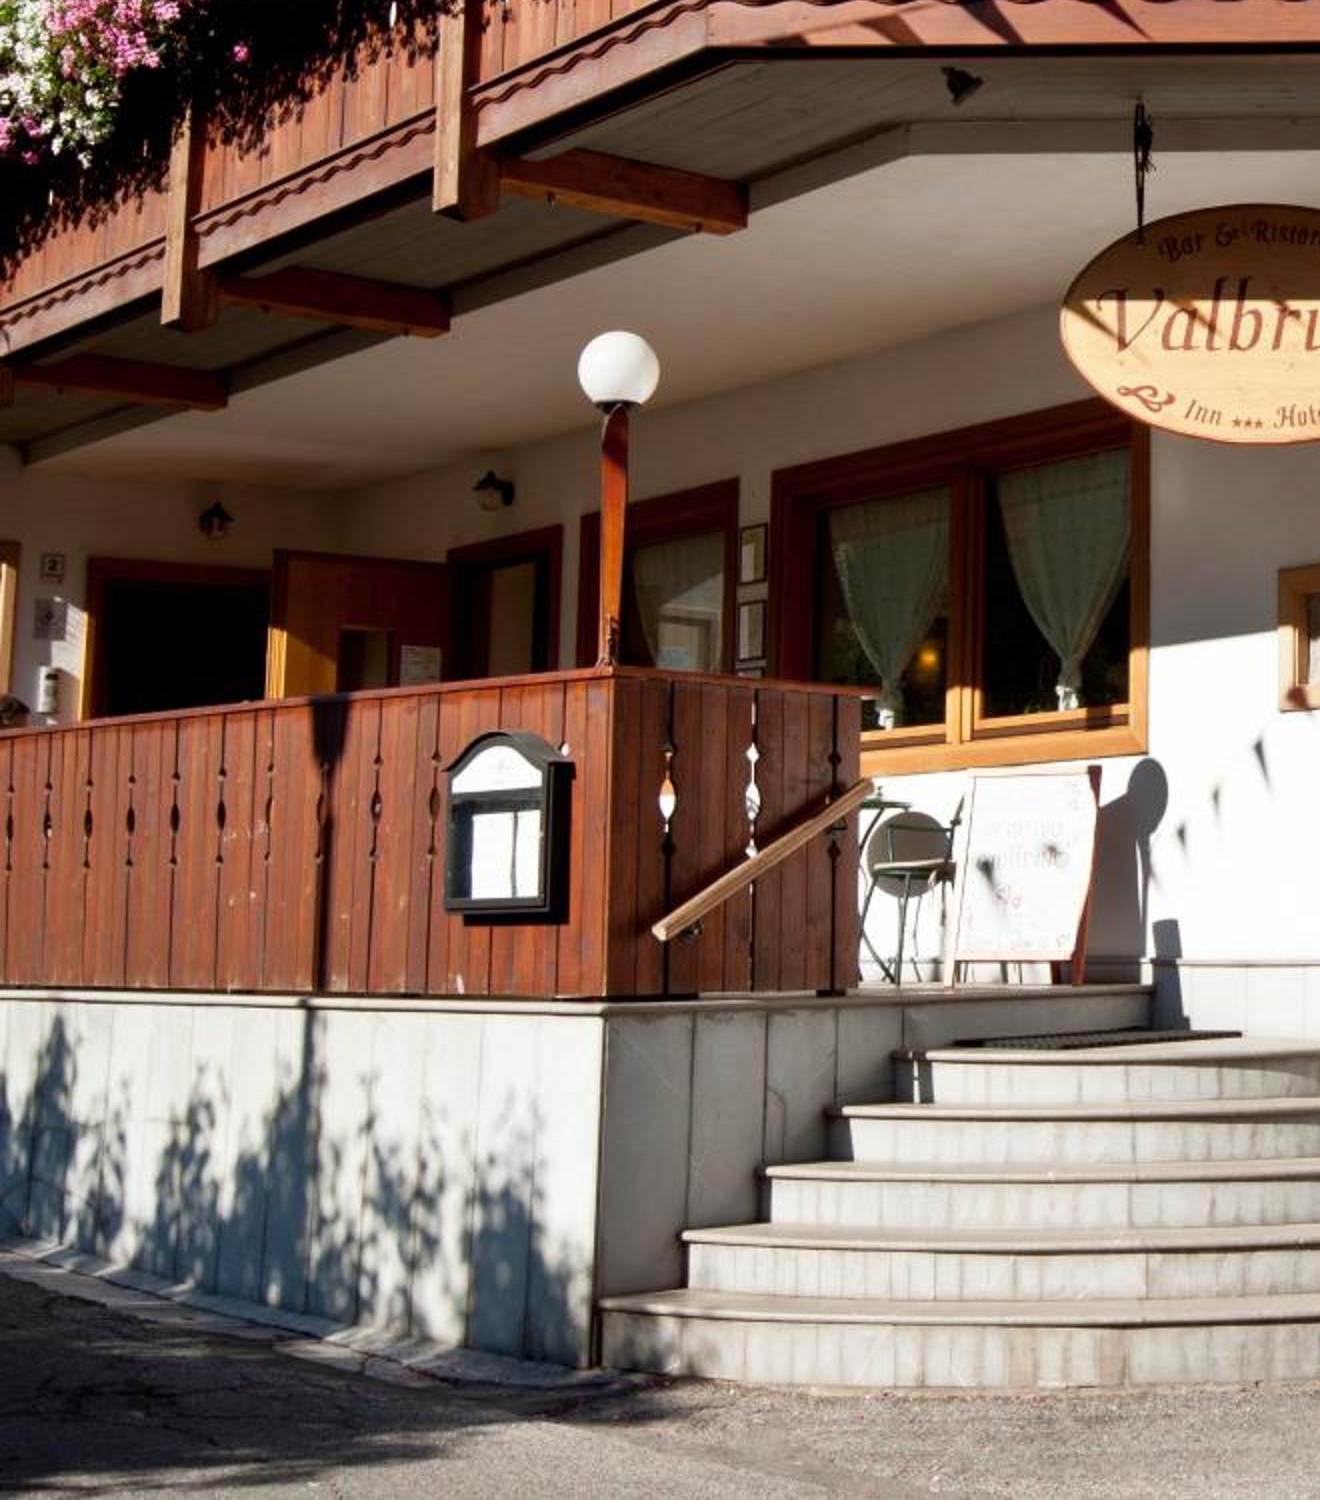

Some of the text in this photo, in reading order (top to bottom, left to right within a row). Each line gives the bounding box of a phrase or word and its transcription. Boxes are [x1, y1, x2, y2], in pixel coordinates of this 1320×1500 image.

[1157, 232, 1204, 262] Bar
[1215, 221, 1240, 247] &
[1184, 399, 1222, 426] Inn
